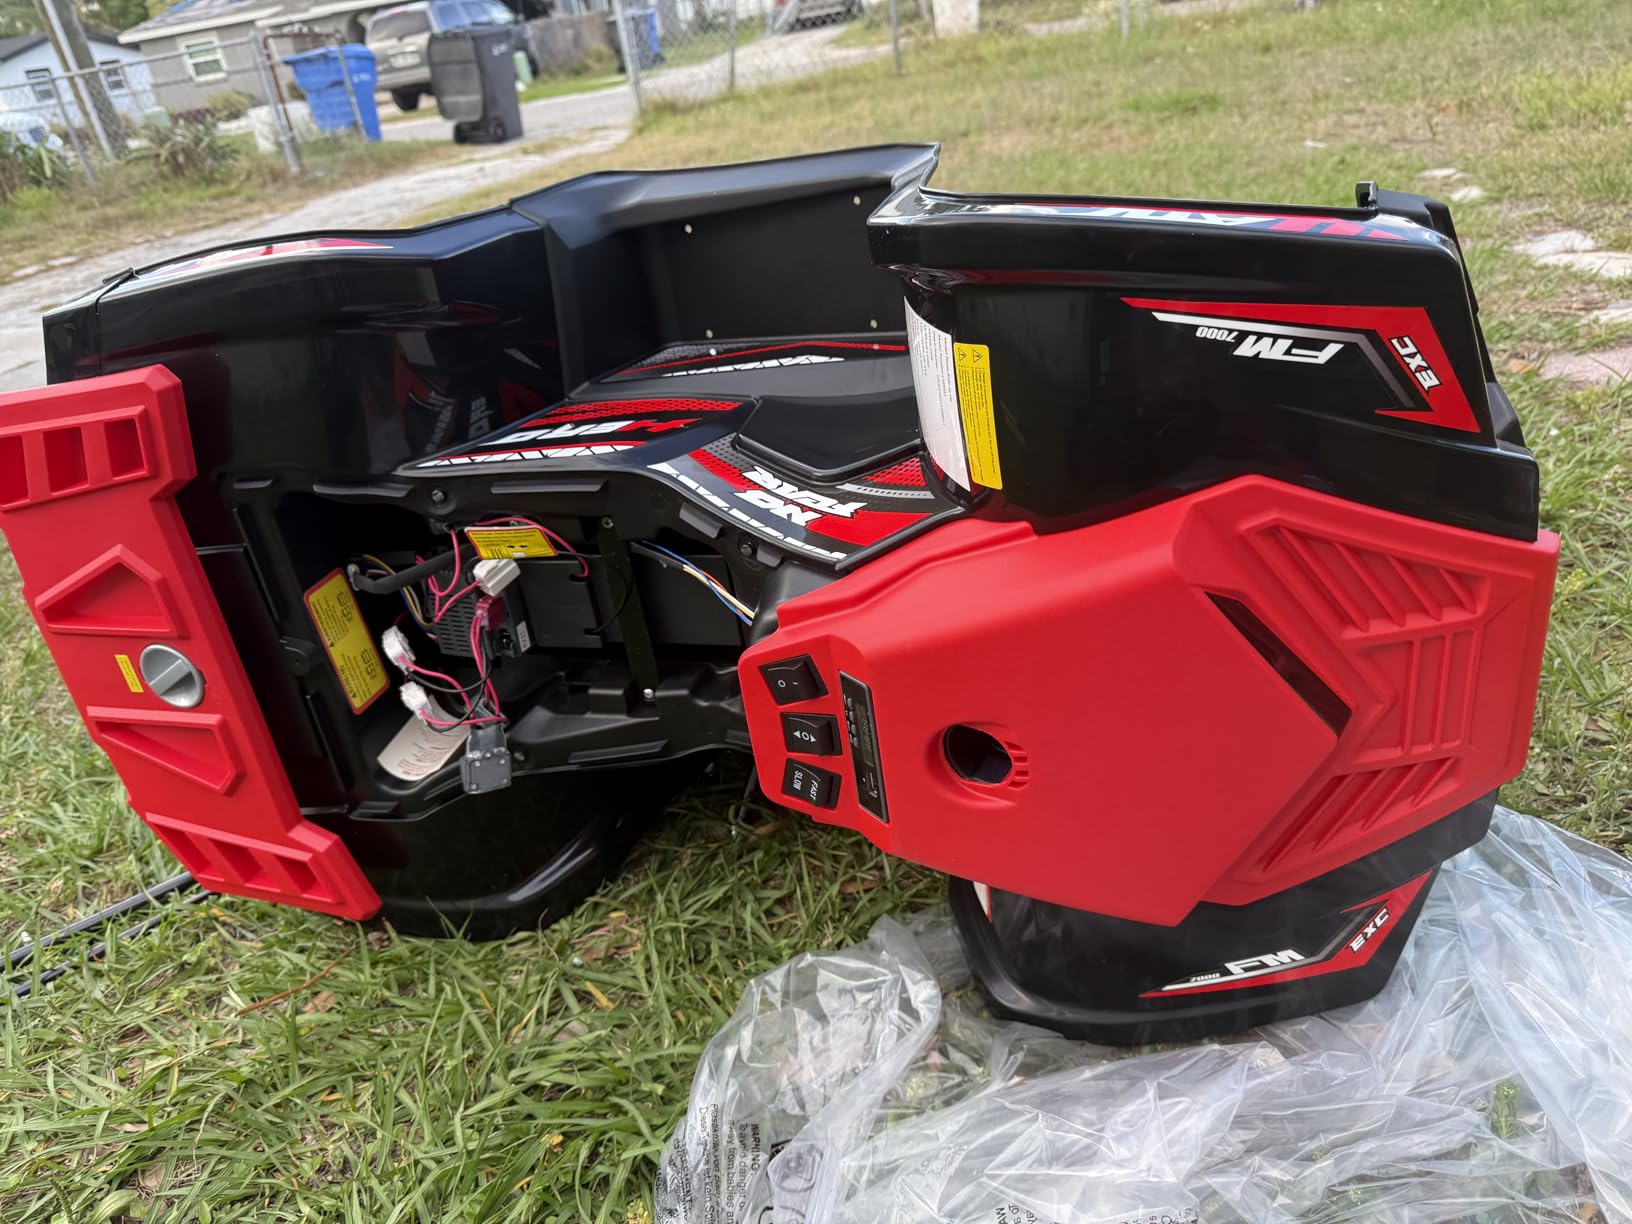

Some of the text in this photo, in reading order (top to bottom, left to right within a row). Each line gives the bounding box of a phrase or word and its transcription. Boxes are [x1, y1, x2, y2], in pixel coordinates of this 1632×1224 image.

[1195, 326, 1344, 364] FM 7000
[1390, 336, 1441, 391] EXC
[734, 489, 823, 527] NO
[742, 465, 868, 518] FEAR
[793, 770, 803, 791] SLOW
[809, 779, 819, 801] FAST
[1349, 908, 1389, 952] EXC
[1223, 949, 1306, 975] FM
[727, 1147, 737, 1171] from
[726, 1172, 738, 1207] babies
[736, 1161, 747, 1198] danger
